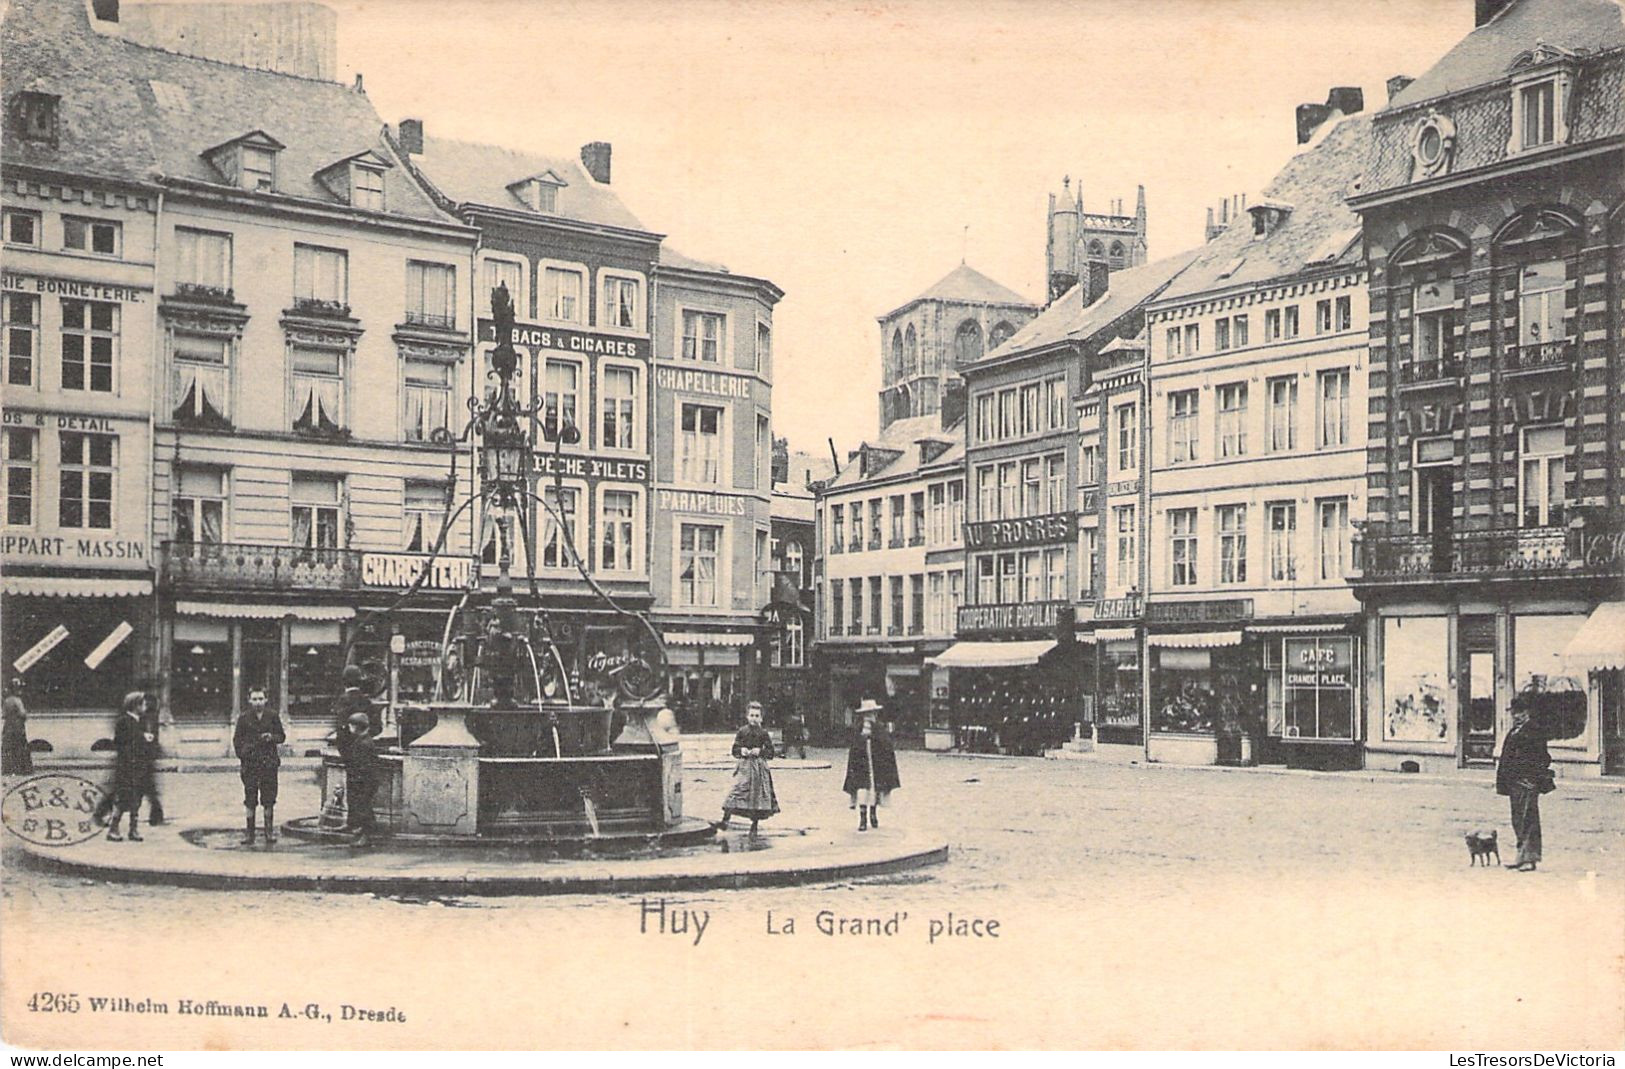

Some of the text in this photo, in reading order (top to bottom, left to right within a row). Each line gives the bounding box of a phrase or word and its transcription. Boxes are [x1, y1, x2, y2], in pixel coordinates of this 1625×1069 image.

[557, 337, 565, 349] &
[571, 336, 636, 356] CIGARES
[657, 368, 750, 398] CHAPELLERIE
[58, 417, 115, 432] DETAIL
[591, 460, 646, 480] FILETS
[660, 490, 745, 515] PARAPLUIES
